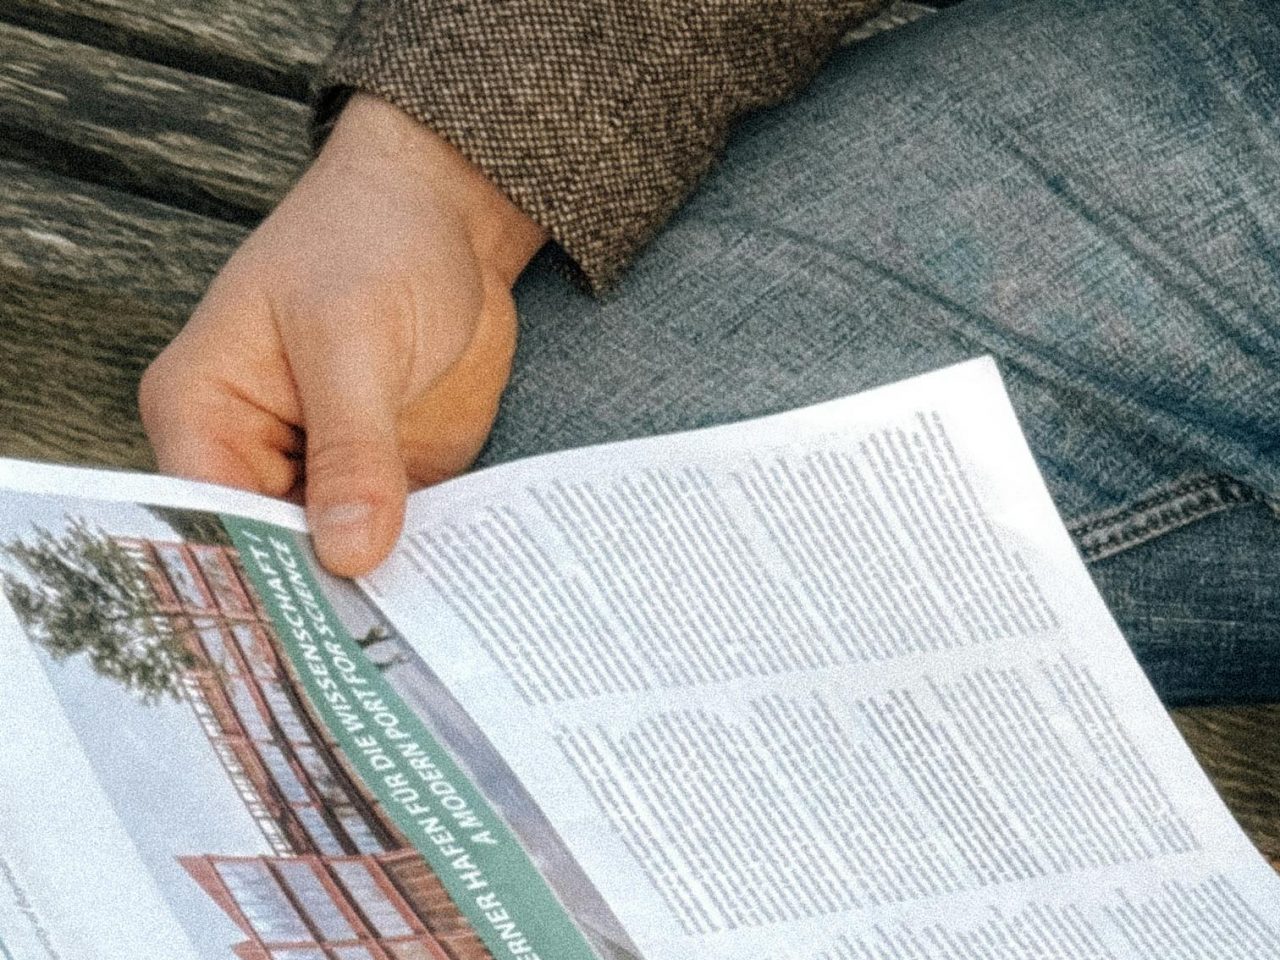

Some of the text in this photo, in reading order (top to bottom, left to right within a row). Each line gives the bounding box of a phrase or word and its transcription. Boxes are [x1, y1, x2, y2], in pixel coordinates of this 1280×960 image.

[250, 545, 365, 733] WISSENSCHAFT
[268, 536, 498, 845] A MODERN PORT FOR SCIENCE
[354, 734, 395, 771] DIE
[384, 768, 430, 815] FÜR
[418, 816, 488, 891] HAFEN
